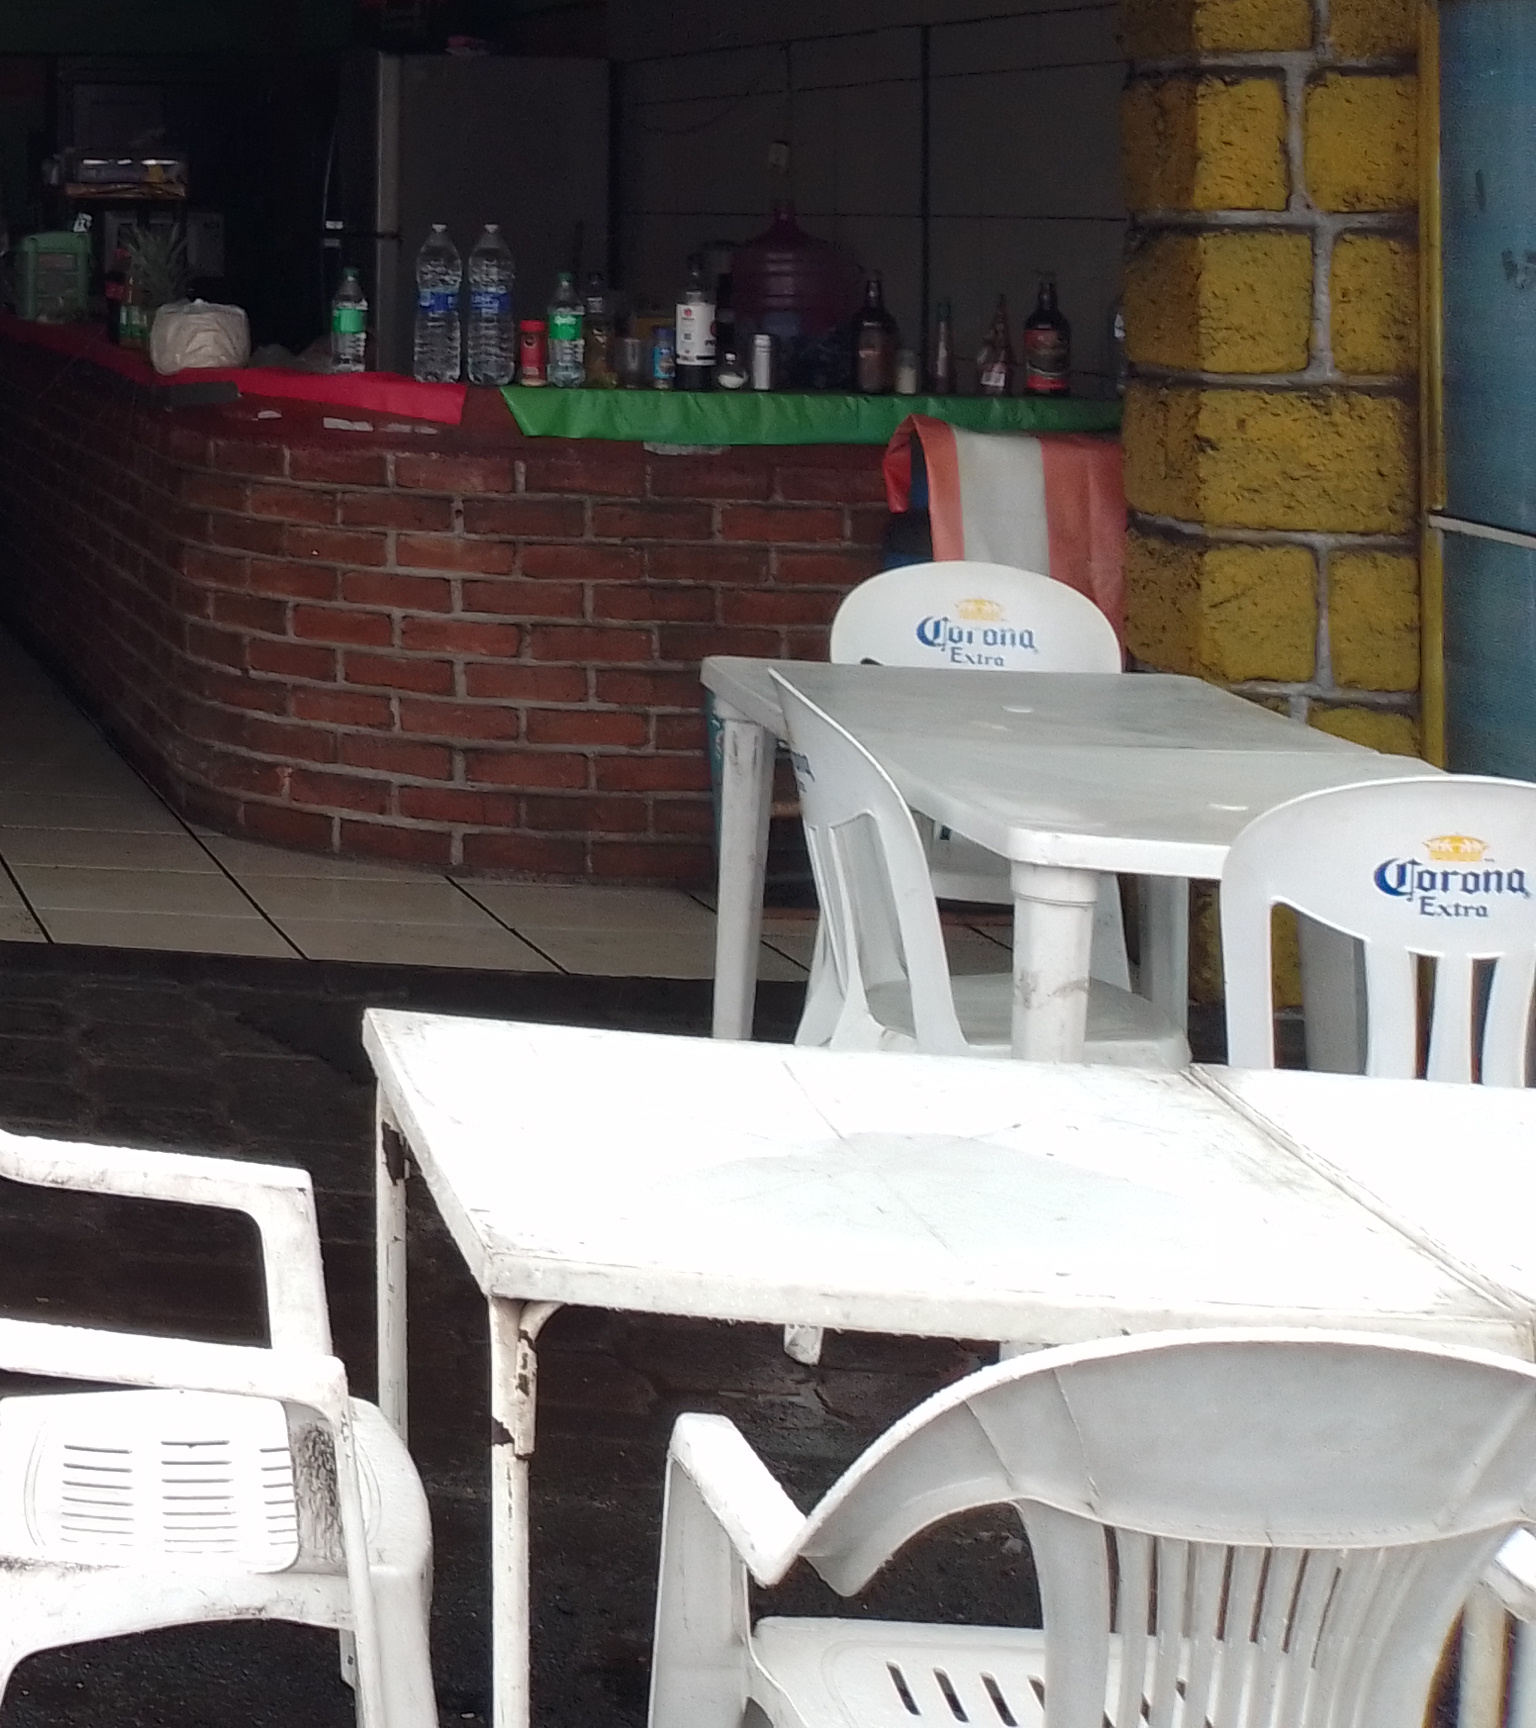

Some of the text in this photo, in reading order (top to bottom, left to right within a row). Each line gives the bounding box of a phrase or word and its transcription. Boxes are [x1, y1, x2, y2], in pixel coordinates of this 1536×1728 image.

[915, 615, 1038, 654] Corona
[950, 646, 1005, 667] Extra
[1373, 857, 1532, 902] Corona
[1419, 895, 1489, 918] Extra
